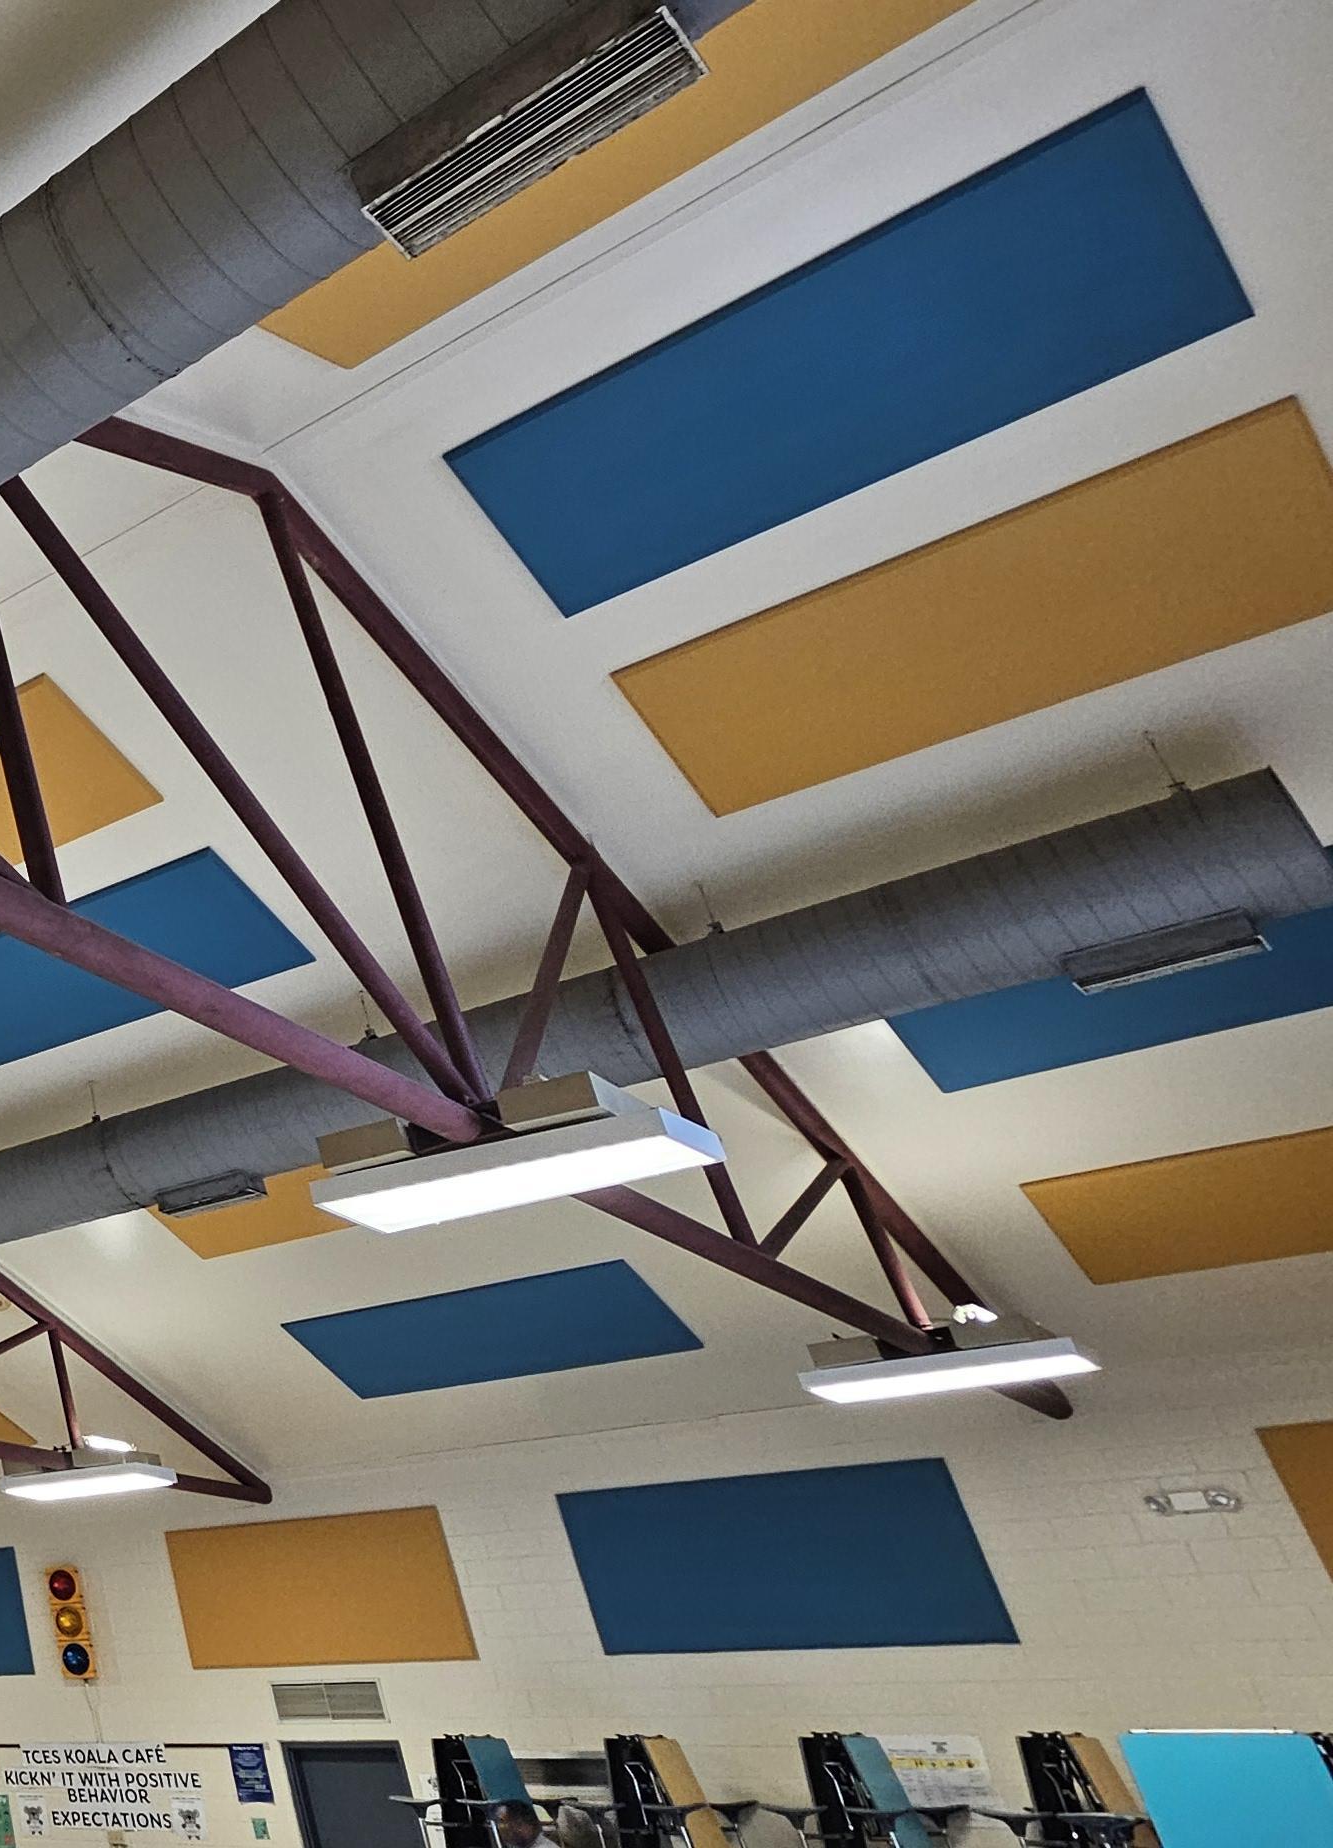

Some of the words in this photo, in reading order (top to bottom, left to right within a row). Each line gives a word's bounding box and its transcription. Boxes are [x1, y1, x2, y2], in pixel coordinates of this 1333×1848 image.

[22, 1750, 61, 1764] TCES
[64, 1749, 118, 1764] KOALA
[122, 1744, 166, 1764] CAFÉ
[61, 1772, 74, 1786] IT
[78, 1772, 120, 1788] WITH
[124, 1773, 202, 1788] POSITIVE
[67, 1788, 151, 1804] BEHAVIOR
[51, 1811, 172, 1829] EXPECTATIONS
